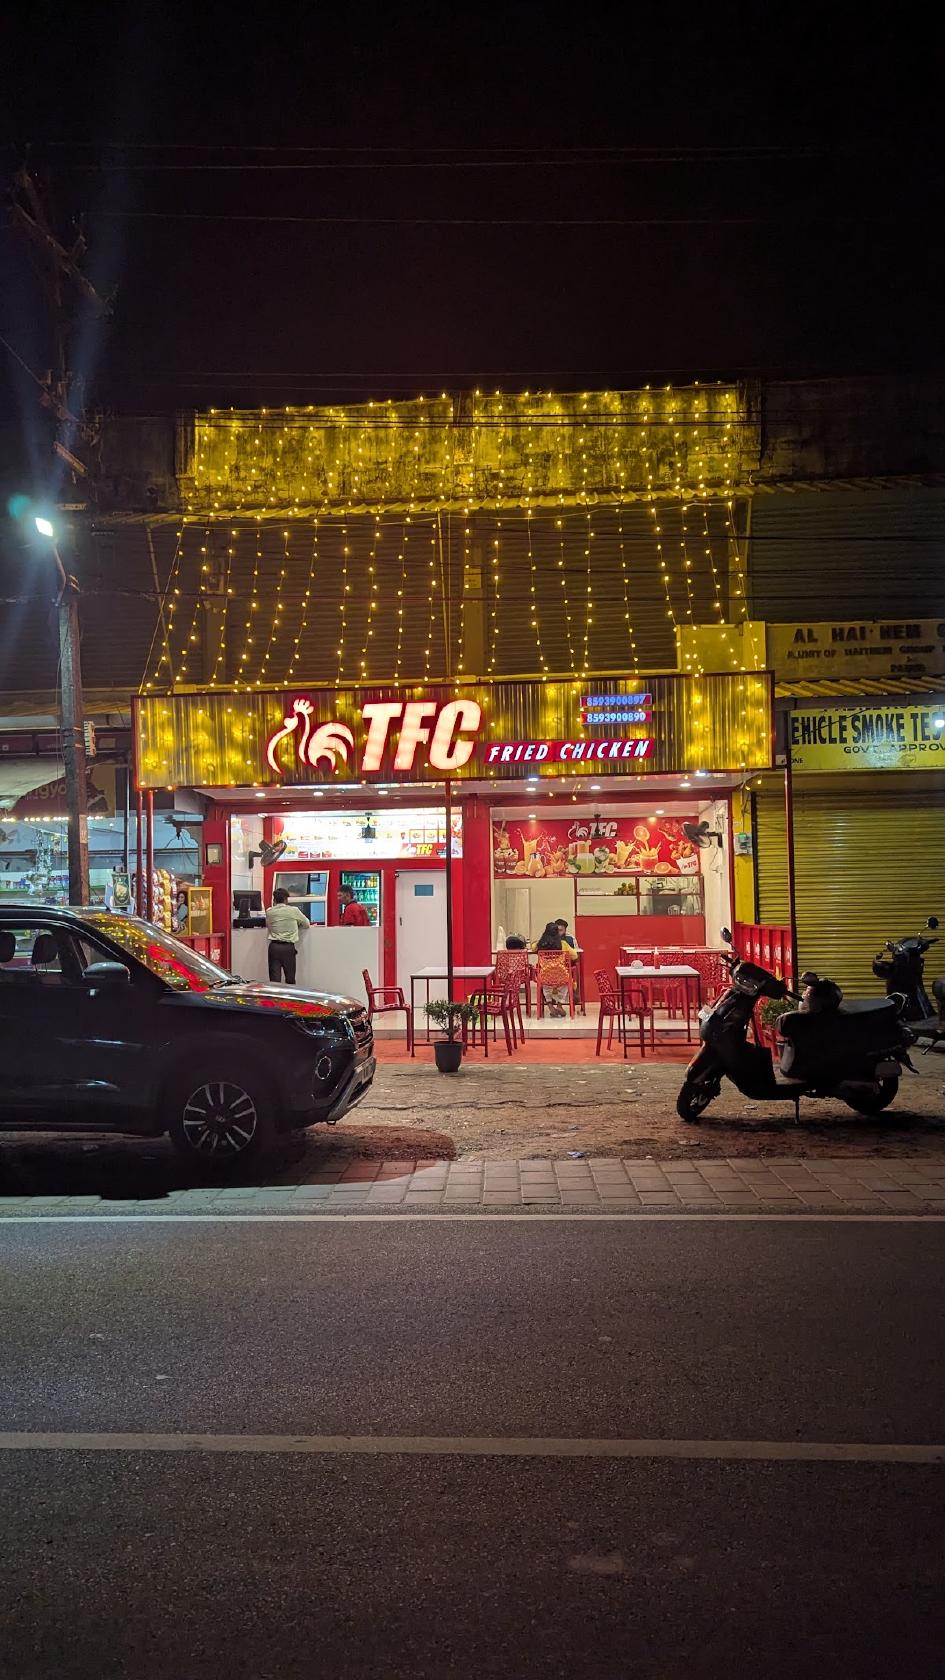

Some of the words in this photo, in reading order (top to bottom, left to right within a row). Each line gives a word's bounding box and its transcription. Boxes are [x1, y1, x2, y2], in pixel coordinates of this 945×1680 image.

[793, 628, 818, 643] AL
[586, 695, 646, 706] 8593900897
[586, 712, 646, 722] 8593900890
[361, 699, 482, 771] TFC
[791, 714, 848, 745] EHICLE
[850, 711, 906, 744] SMOKE
[488, 745, 549, 762] FRIED
[560, 740, 650, 760] CHICKEN
